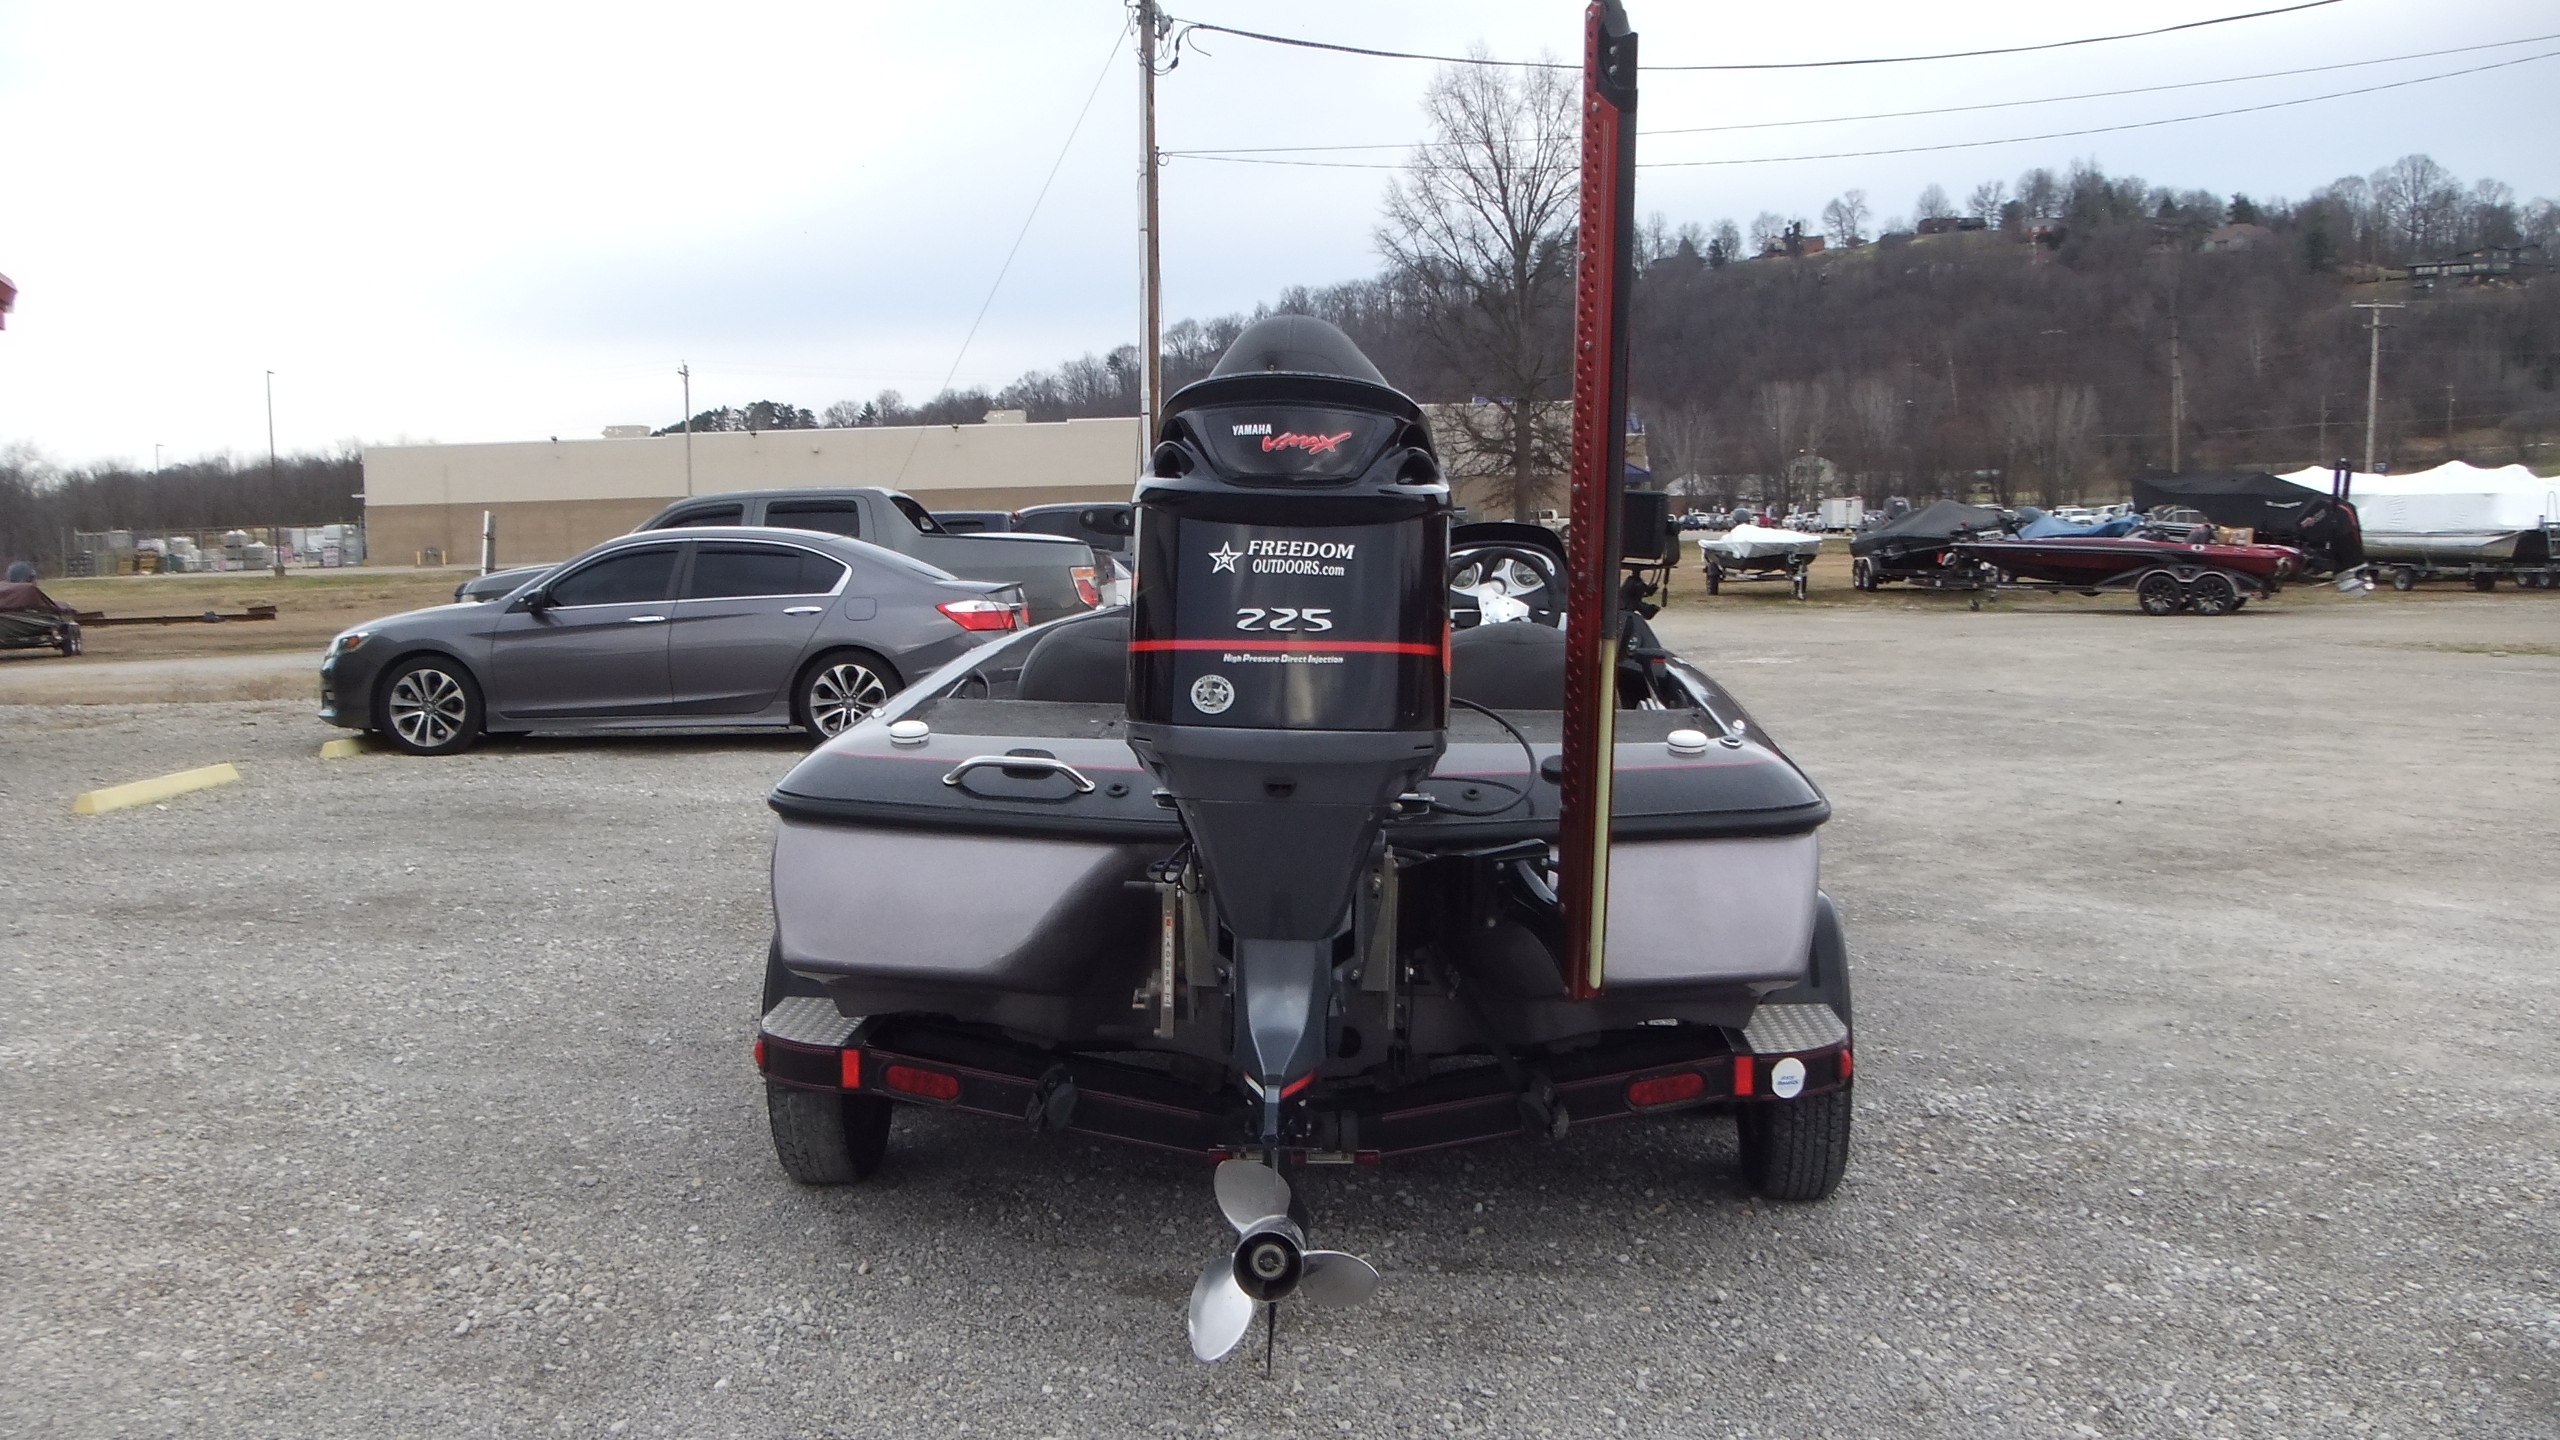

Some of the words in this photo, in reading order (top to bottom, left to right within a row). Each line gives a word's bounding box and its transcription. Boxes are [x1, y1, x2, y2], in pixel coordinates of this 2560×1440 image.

[1232, 424, 1272, 436] YAMAHA
[1247, 540, 1356, 560] FREEDOM
[1252, 559, 1345, 577] OUTDOORS.com
[1236, 606, 1333, 632] 225
[1222, 653, 1242, 664] High
[1242, 653, 1280, 664] Pressure
[1280, 653, 1308, 664] Direct
[1307, 654, 1344, 665] Injection
